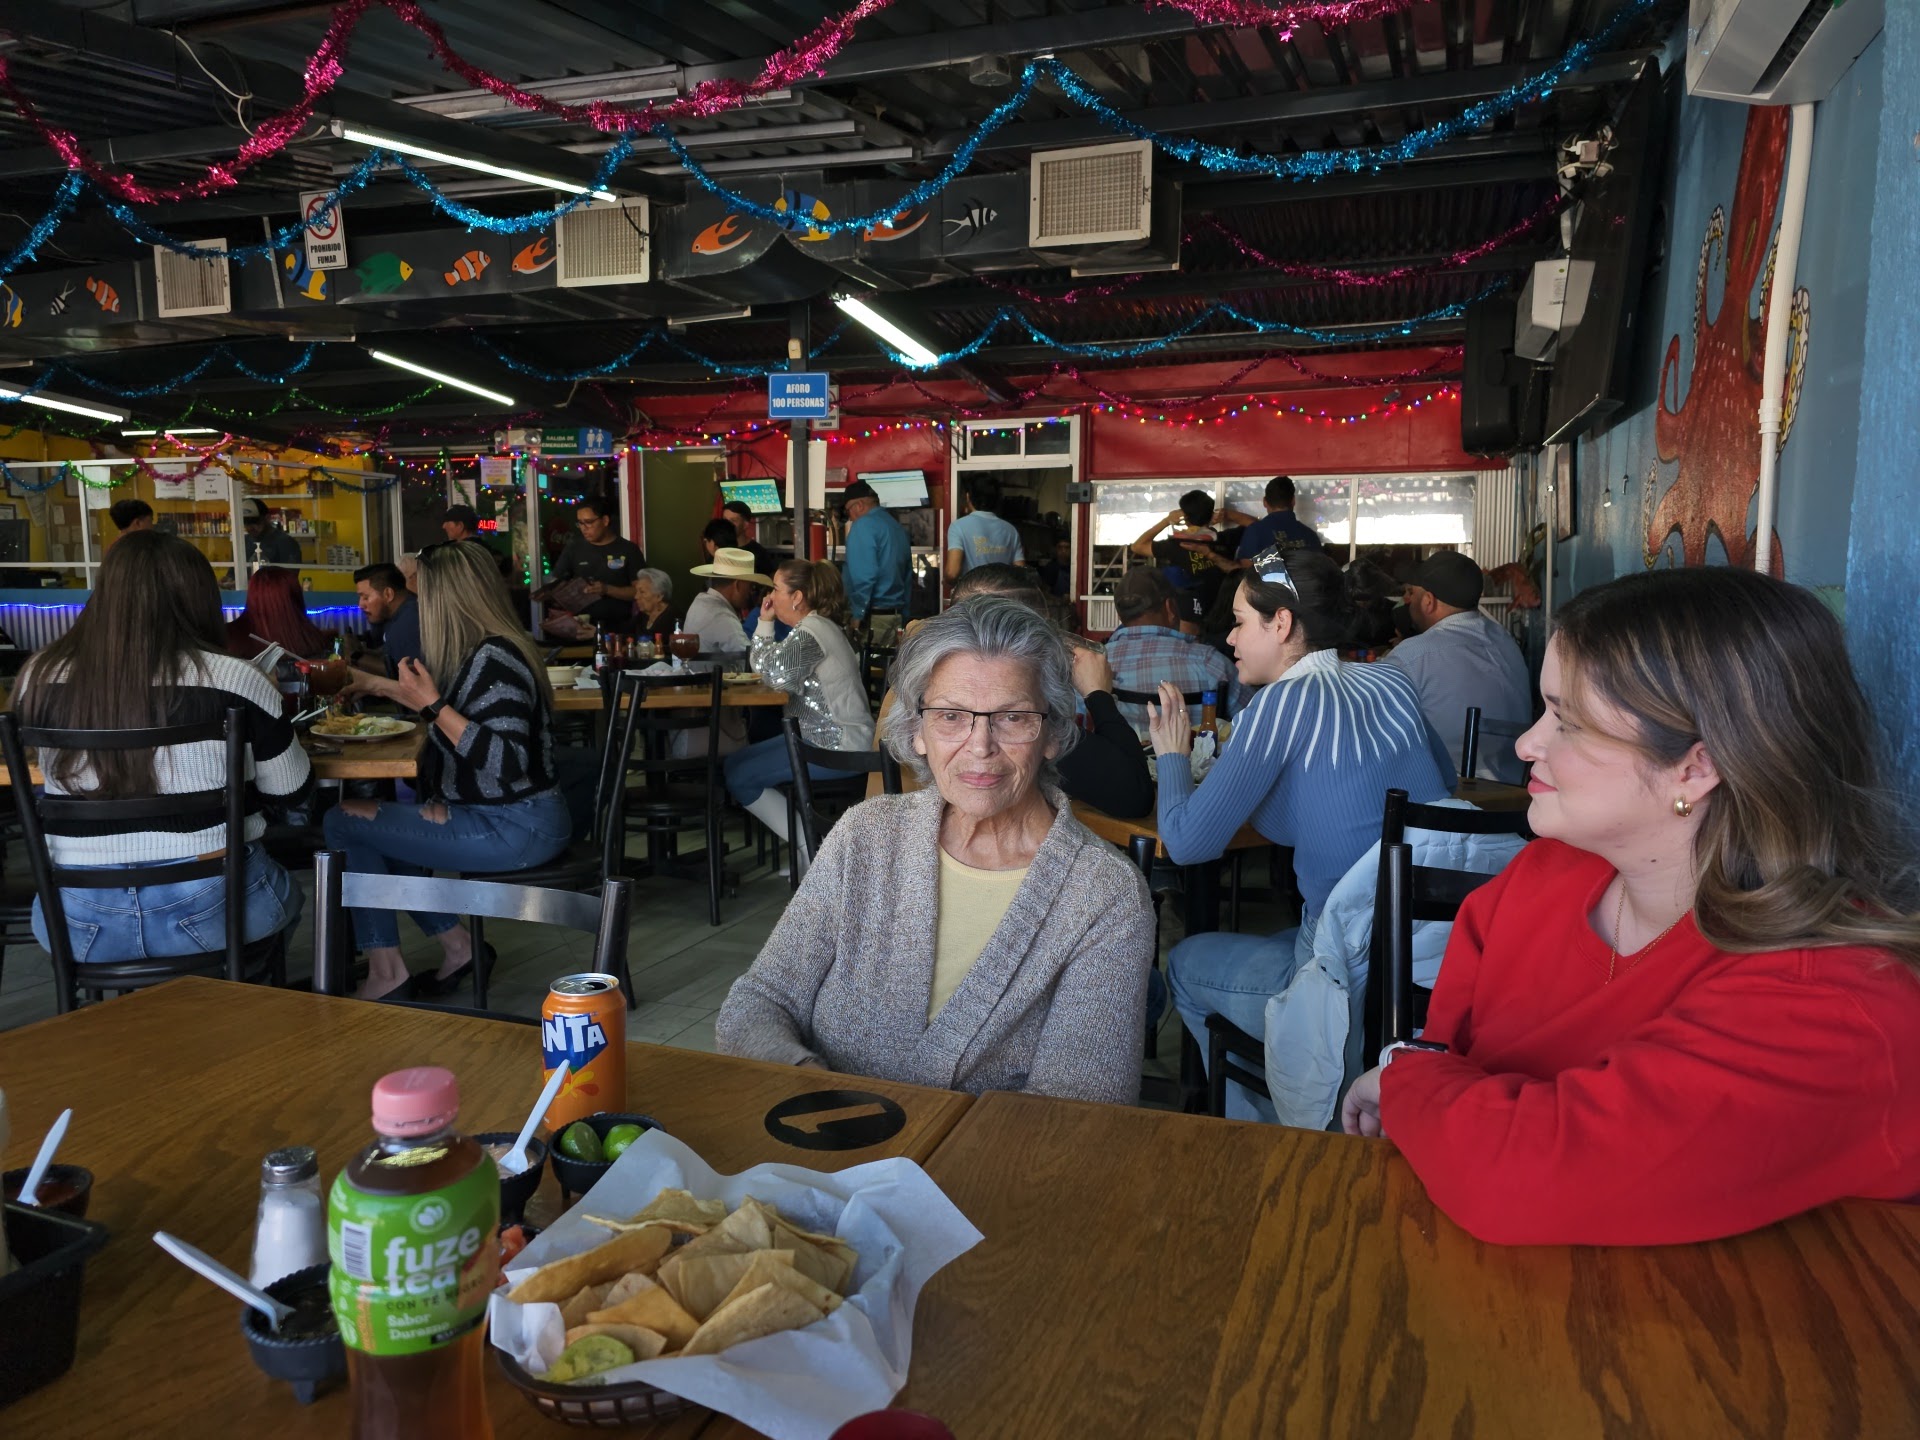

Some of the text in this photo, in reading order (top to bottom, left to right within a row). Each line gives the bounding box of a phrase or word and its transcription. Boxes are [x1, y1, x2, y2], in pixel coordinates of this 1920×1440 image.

[311, 243, 341, 253] PROHIBIDO
[318, 255, 337, 264] FUMAR
[786, 384, 810, 393] AFORO
[772, 398, 824, 407] 100 PERSONAS
[1192, 598, 1203, 614] LA
[384, 1226, 481, 1273] fuze
[384, 1265, 457, 1297] tea
[385, 1300, 416, 1310] CON
[387, 1312, 432, 1328] Sabor
